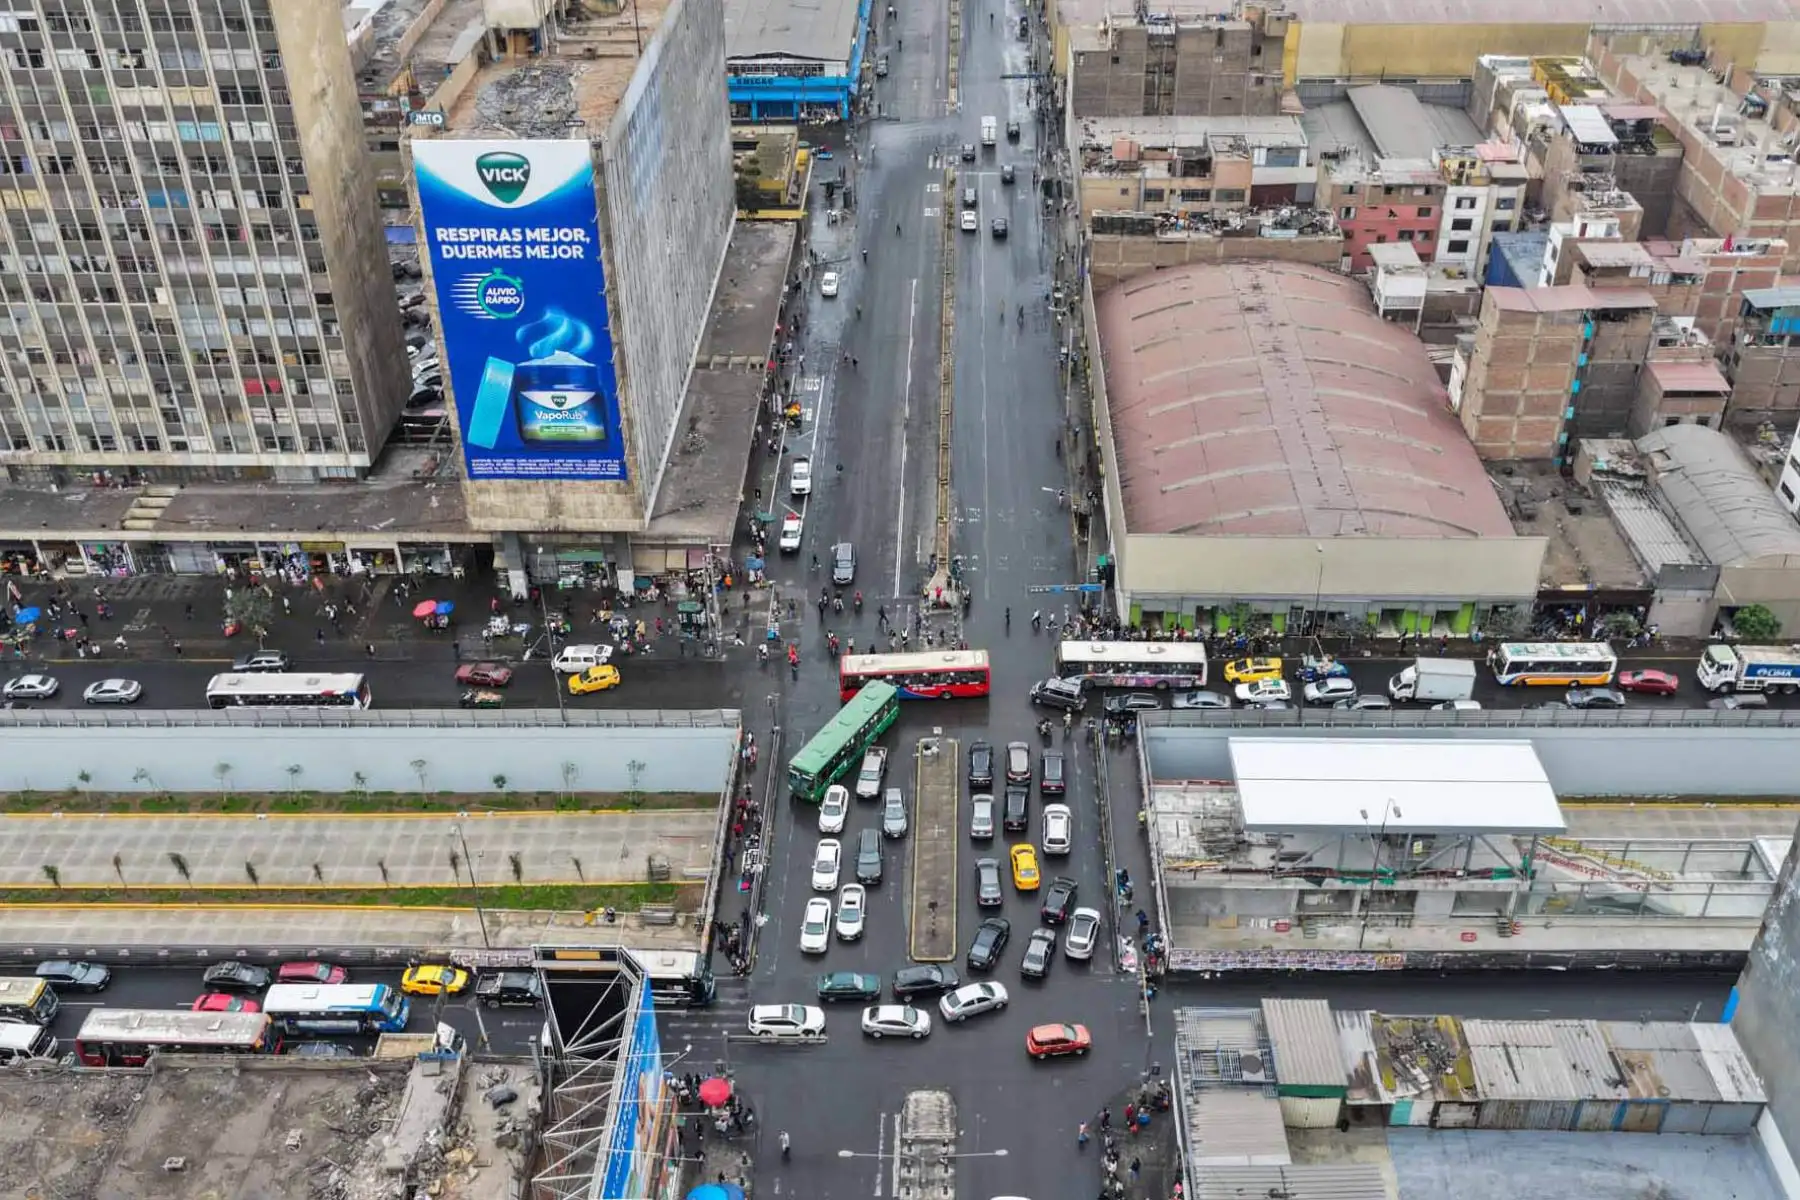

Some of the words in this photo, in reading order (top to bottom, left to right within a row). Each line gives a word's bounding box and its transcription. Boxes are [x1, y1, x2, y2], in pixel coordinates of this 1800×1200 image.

[481, 167, 526, 182] VICK
[435, 227, 523, 242] RESPIRAS
[525, 227, 591, 244] MEJOR,
[441, 244, 523, 259] DUERMES
[525, 244, 585, 259] MEJOR
[486, 287, 516, 295] ALIVIO
[535, 410, 583, 422] VapoRub
